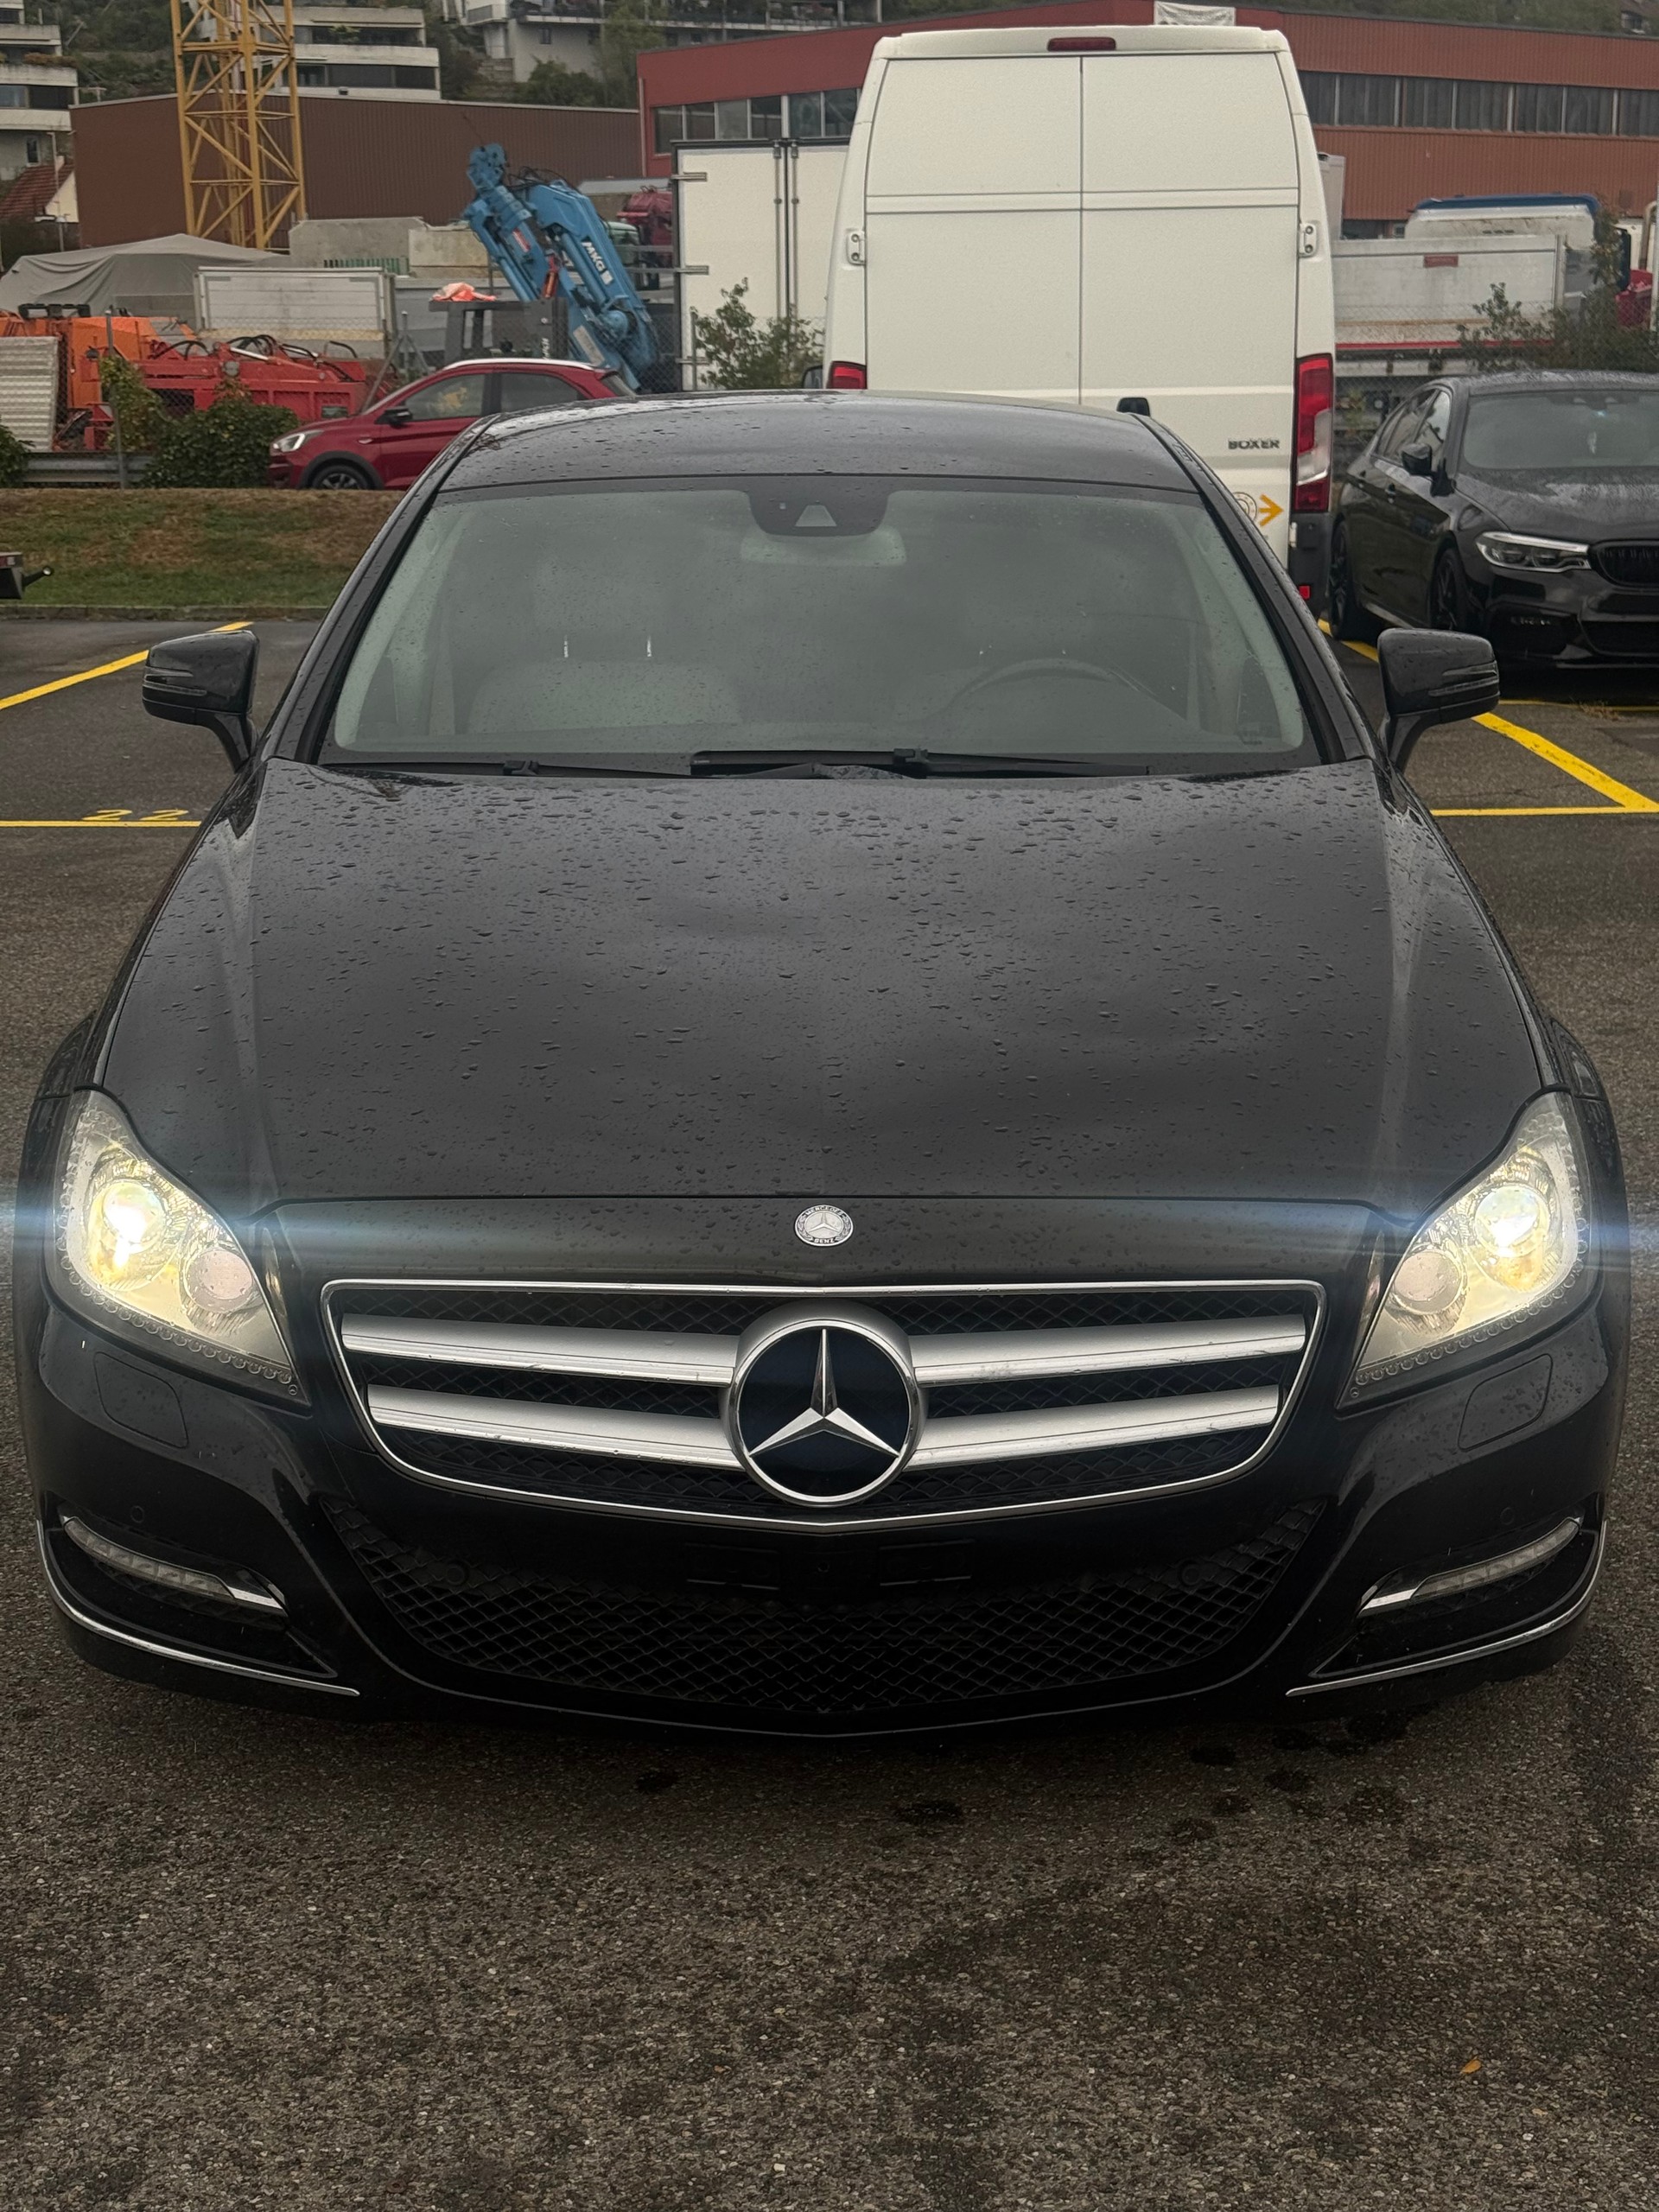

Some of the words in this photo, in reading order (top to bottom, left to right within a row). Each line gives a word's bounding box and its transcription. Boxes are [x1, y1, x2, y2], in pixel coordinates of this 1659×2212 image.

[581, 241, 607, 272] MKG
[1228, 438, 1281, 449] BOXER
[81, 809, 189, 821] 22
[804, 1205, 844, 1217] MERCEDES
